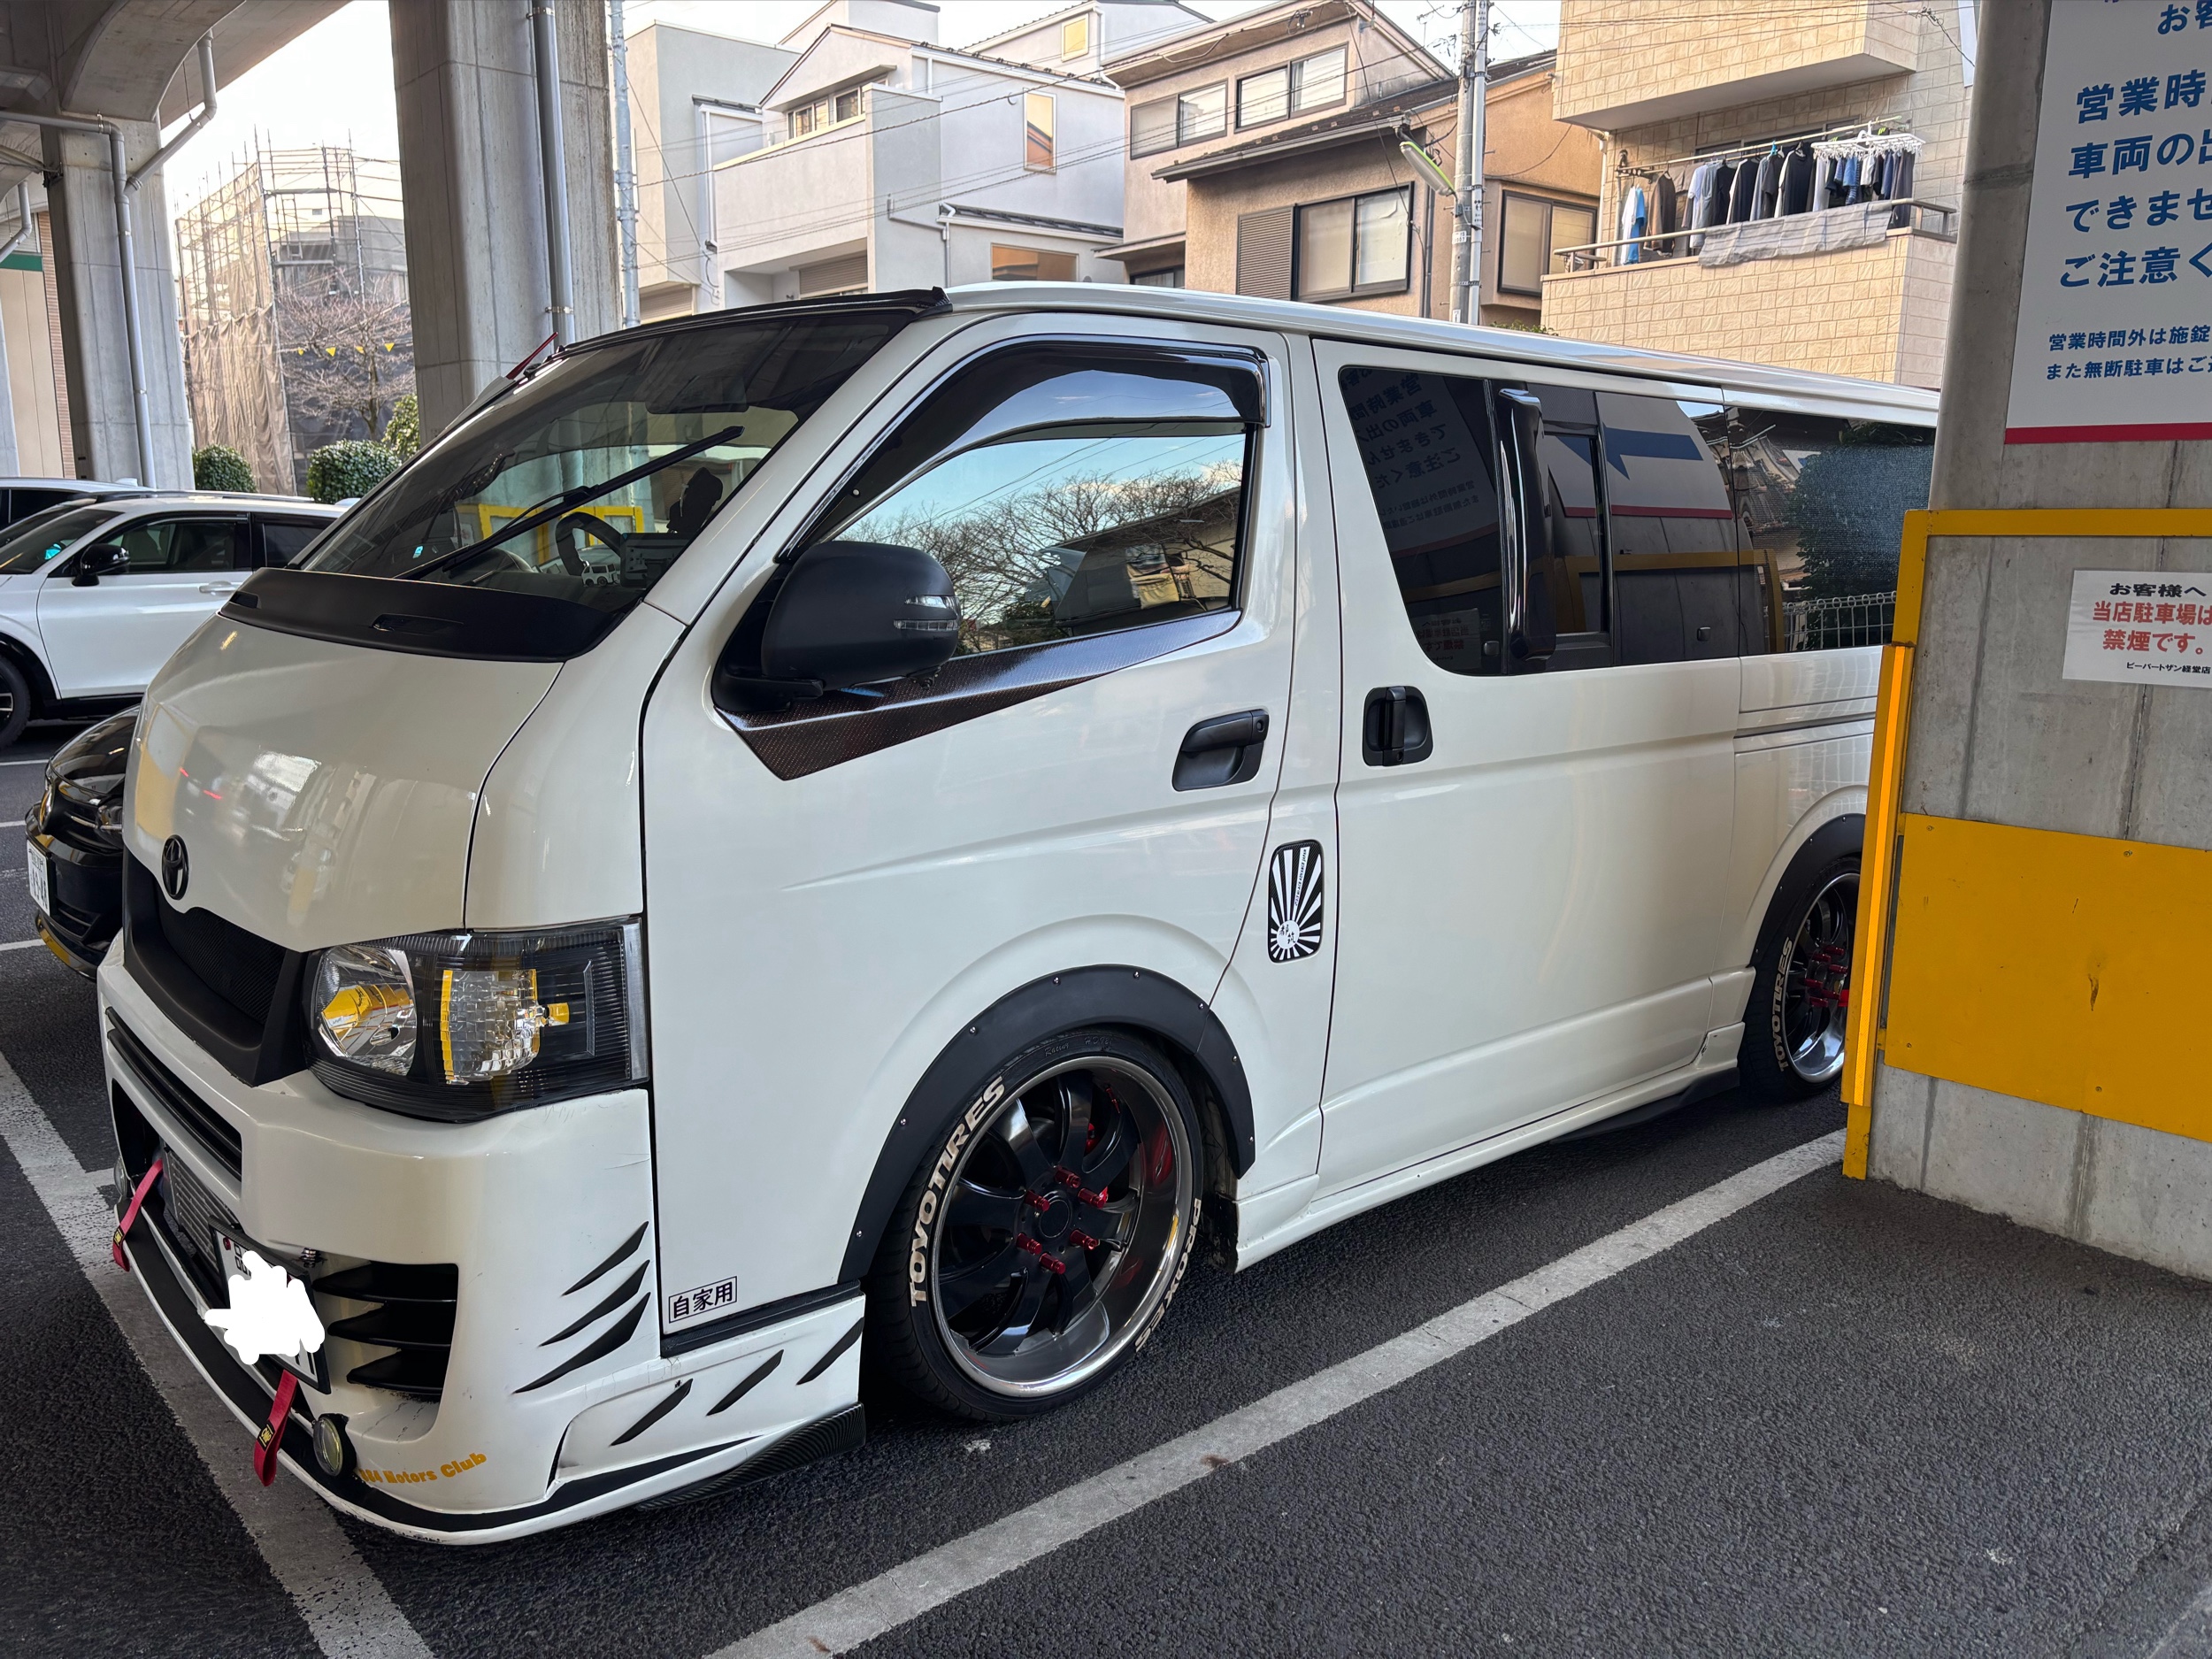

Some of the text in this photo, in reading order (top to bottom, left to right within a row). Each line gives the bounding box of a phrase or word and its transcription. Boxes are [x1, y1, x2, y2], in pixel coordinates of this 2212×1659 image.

[2065, 188, 2212, 232] できませ
[2060, 242, 2212, 288] ご注意く
[2048, 325, 2211, 351] 営業時間外は施錠
[2047, 356, 2212, 380] また無断駐車はご
[2109, 583, 2207, 598] お客様へ
[2093, 600, 2212, 626] 当店駐車場は
[2102, 629, 2203, 655] 禁煙です。
[2126, 662, 2211, 674] ビーバートザン経堂店
[673, 1281, 733, 1318] 自家用
[383, 1469, 438, 1483] Motors
[440, 1452, 487, 1478] Club
